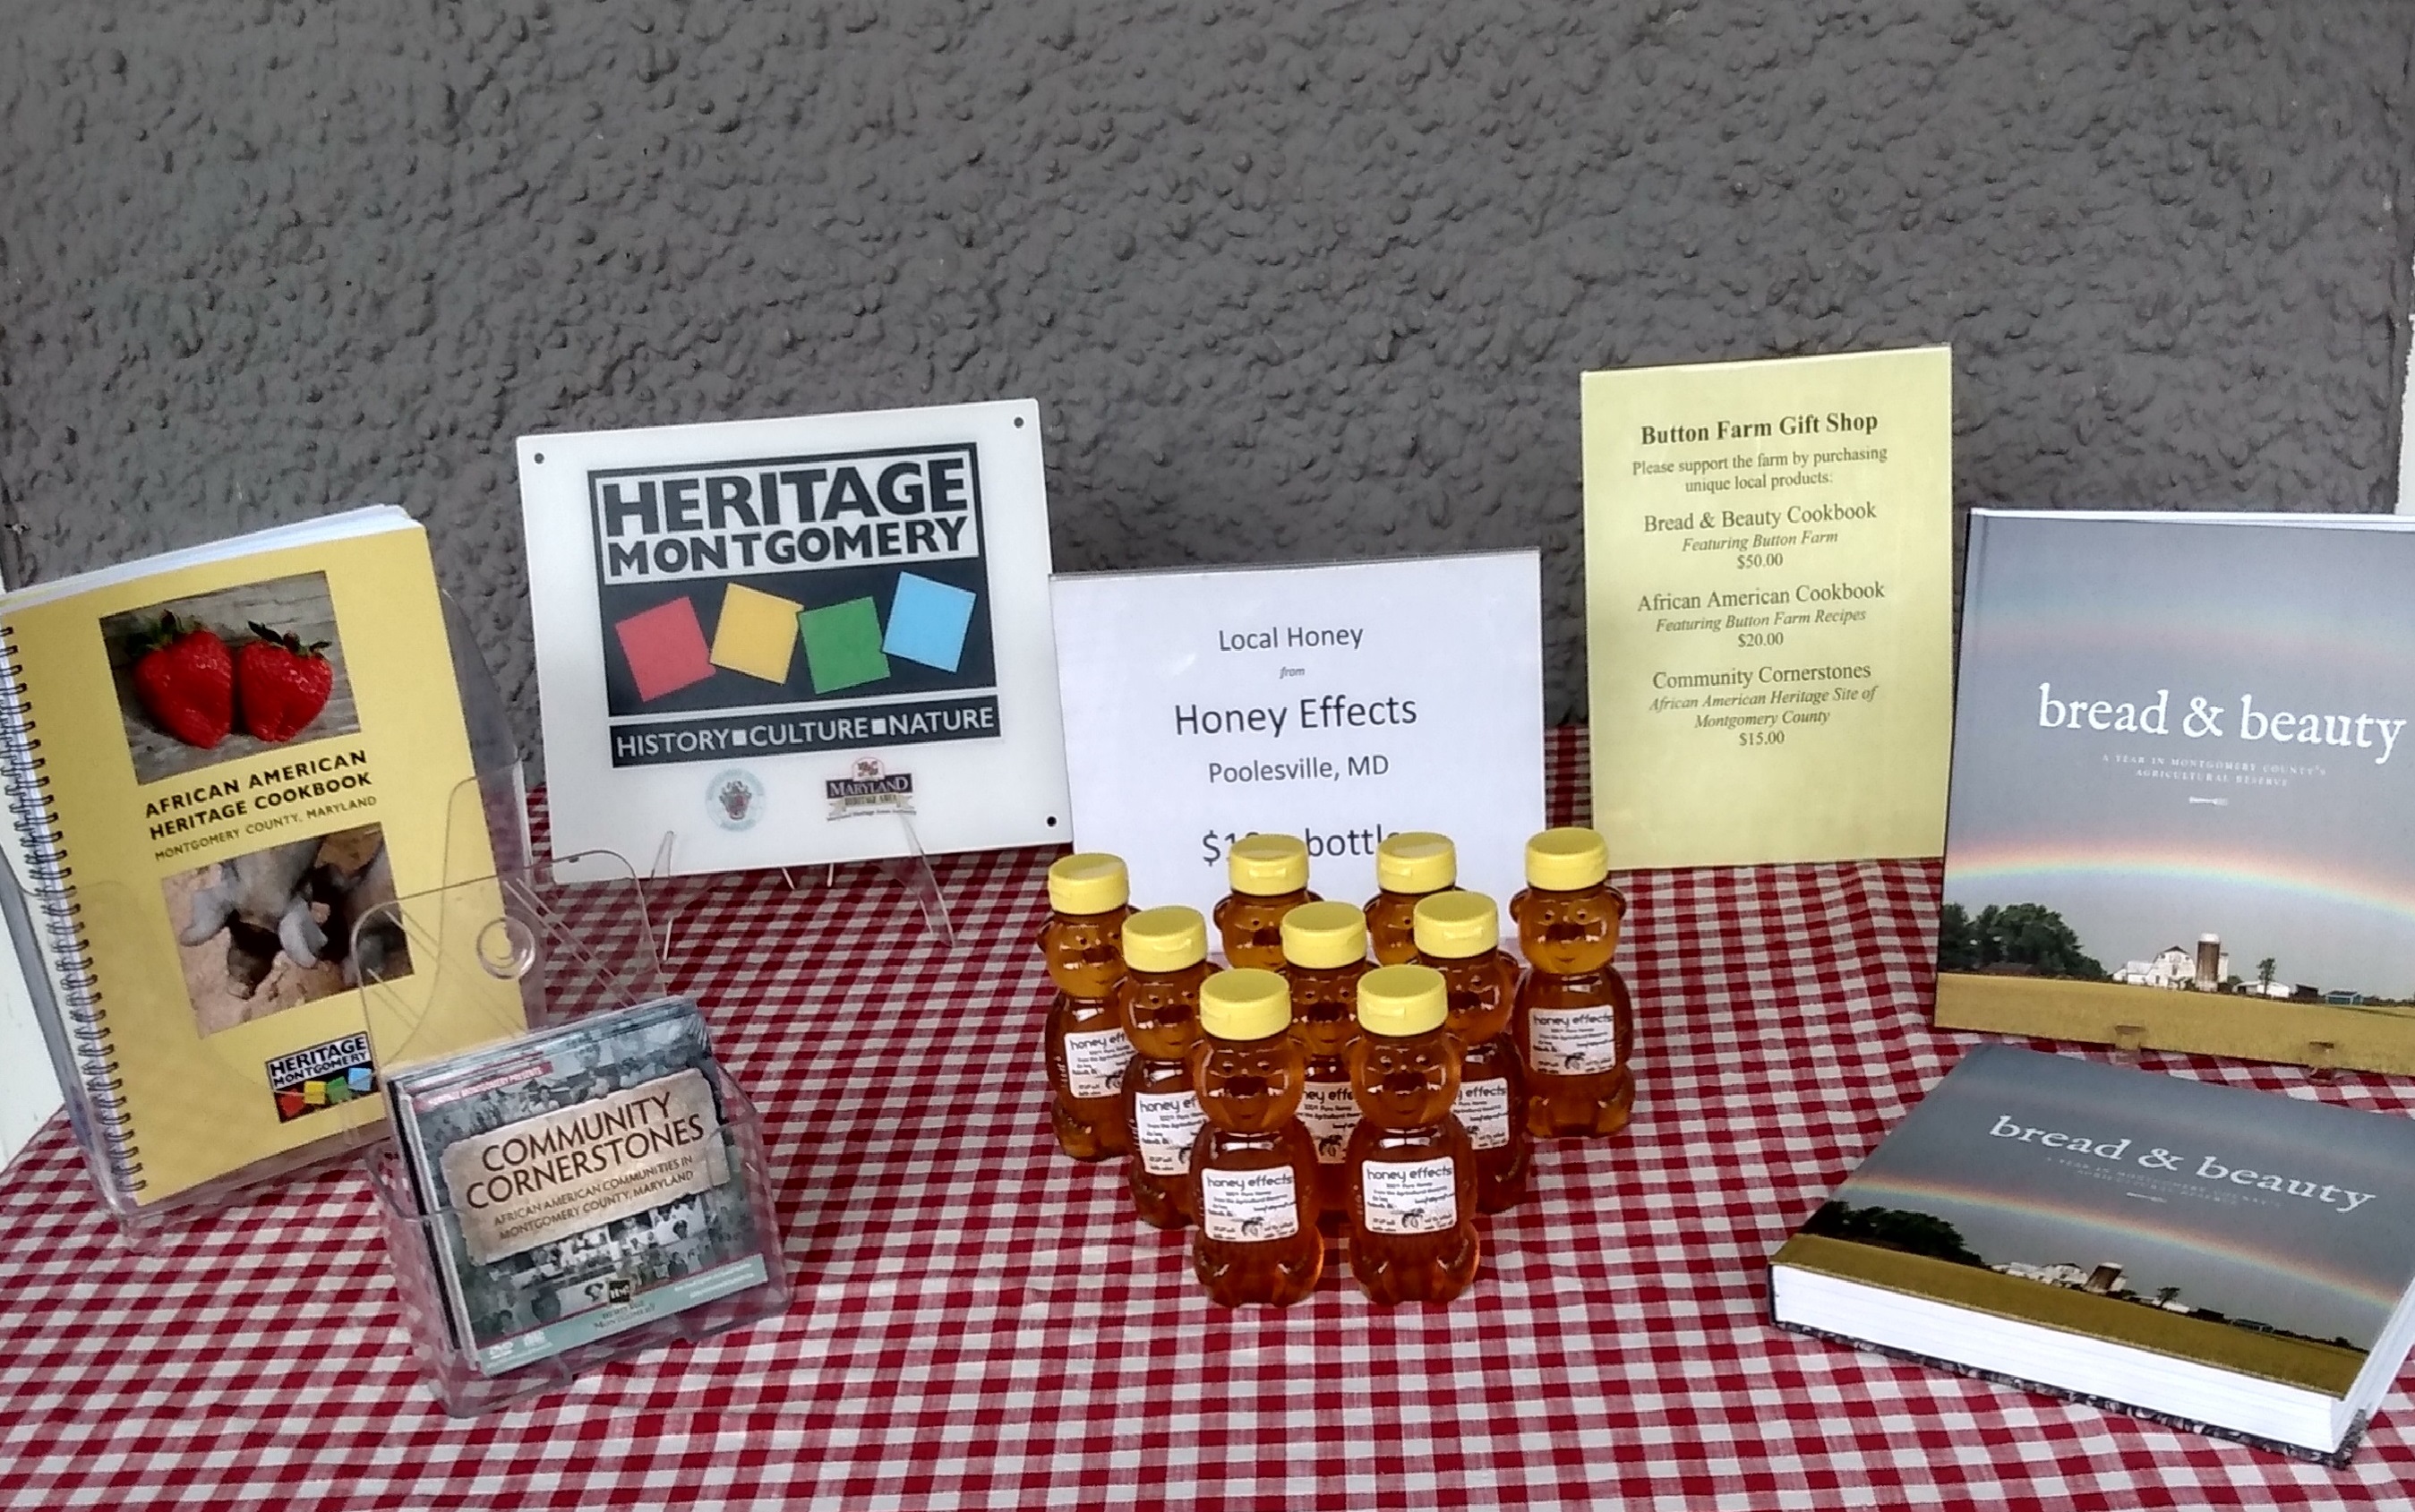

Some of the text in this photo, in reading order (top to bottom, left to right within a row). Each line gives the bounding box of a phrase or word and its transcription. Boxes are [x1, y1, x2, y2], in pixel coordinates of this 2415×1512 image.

[1641, 413, 1878, 445] Button Farm Gift Shop
[1632, 446, 1888, 475] Please support the farm by purchasing
[604, 457, 968, 536] HERITAGE
[1685, 470, 1833, 494] unique local products:
[1644, 501, 1877, 532] Bread & Beauty Cookbook
[608, 517, 968, 576] MONTGOMERY
[1682, 531, 1837, 552] Featuring Button Farm
[1736, 552, 1784, 569] $50.00
[1638, 581, 1885, 611] African American Cookbook
[1656, 607, 1866, 633] Featuring Button Farm Recipes
[1219, 626, 1364, 652] Local Honey
[1737, 632, 1784, 648] $20.00
[1279, 666, 1306, 679] from
[1652, 662, 1871, 689] Community Cornerstones
[1649, 686, 1879, 713] African American Heritage Site of
[1175, 694, 1417, 738] Honey Effects
[1694, 710, 1830, 730] Montgomery County
[2038, 682, 2406, 764] bread & beauty
[617, 705, 995, 758] HISTORY CULTURE NATURE
[1739, 730, 1785, 746] $15.00
[145, 749, 367, 818] AFRICAN AMERICAN
[1209, 755, 1390, 783] Poolesville, MD
[829, 776, 908, 797] MARYLAND
[150, 772, 373, 840] HERITAGE COOKBOOK
[155, 829, 241, 861] MONTGOMERY
[306, 796, 378, 820] MARYLAND
[1306, 824, 1400, 858] bottl
[270, 1037, 366, 1077] HERITAGE
[1070, 1036, 1107, 1051] honey
[273, 1051, 366, 1088] MONTGOMERY
[1140, 1100, 1179, 1113] honey
[482, 1092, 672, 1172] COMMUNITY
[467, 1115, 704, 1209] CORNERSTONES
[1367, 1166, 1452, 1183] honey effects
[1988, 1115, 2132, 1162] bread
[2137, 1148, 2185, 1173] &
[2197, 1155, 2376, 1213] beauty
[494, 1155, 693, 1226] AFRICAN AMERICAN COMMUNITIES IN
[1207, 1174, 1293, 1191] honey effects
[499, 1207, 580, 1240] MONTGOMERY
[633, 1170, 694, 1202] MARYLAND
